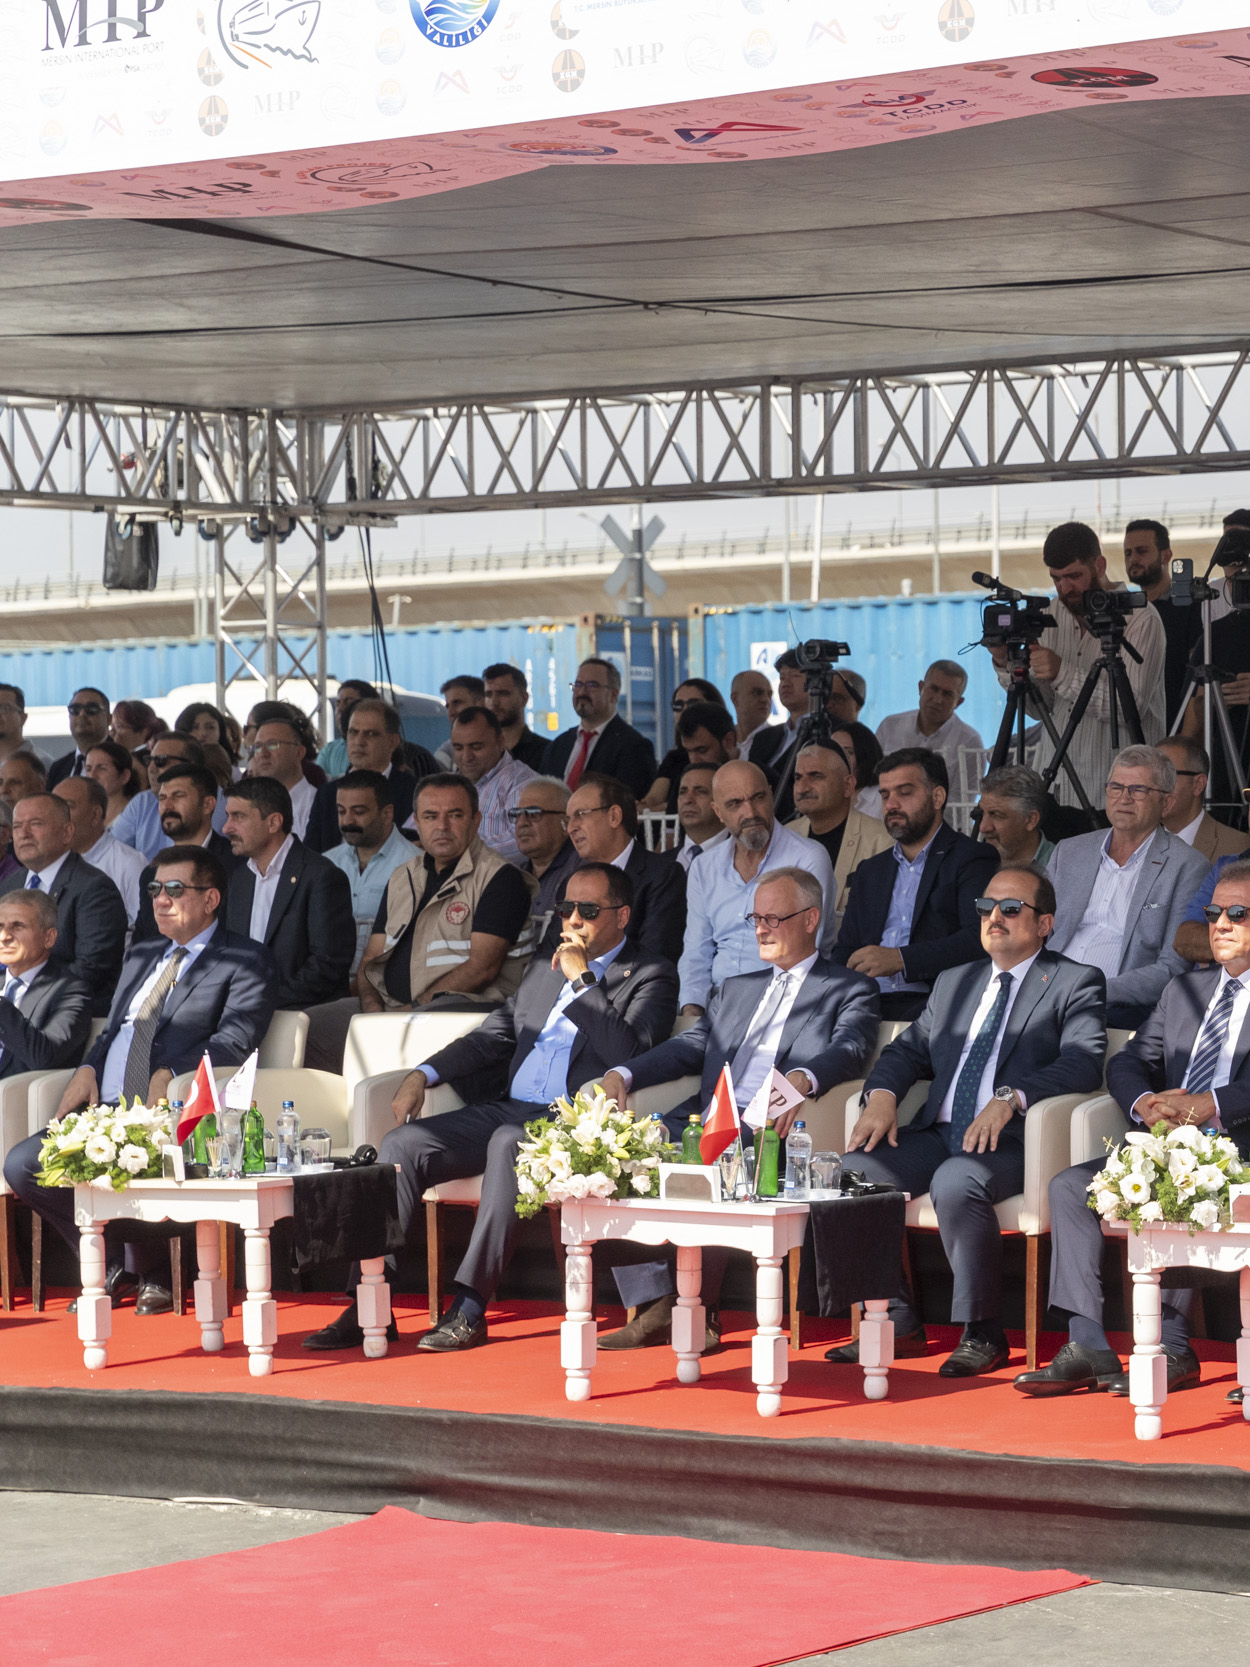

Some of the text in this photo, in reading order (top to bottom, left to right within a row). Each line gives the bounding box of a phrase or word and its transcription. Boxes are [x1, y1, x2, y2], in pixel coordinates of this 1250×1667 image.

[41, 0, 166, 51] MIP
[946, 19, 966, 28] KGM
[40, 41, 165, 68] MERSIN INTERNATIONAL PORT
[613, 42, 665, 69] MIP
[1029, 50, 1087, 63] MIP
[559, 70, 578, 79] KGM
[1073, 75, 1130, 84] KGM
[496, 84, 523, 95] TCDD
[1149, 85, 1206, 95] MIP
[253, 90, 301, 115] MIP
[881, 98, 968, 117] TCDD
[204, 115, 222, 124] KGM
[636, 107, 690, 120] MIP
[764, 140, 817, 152] MIP
[119, 181, 257, 202] MIP
